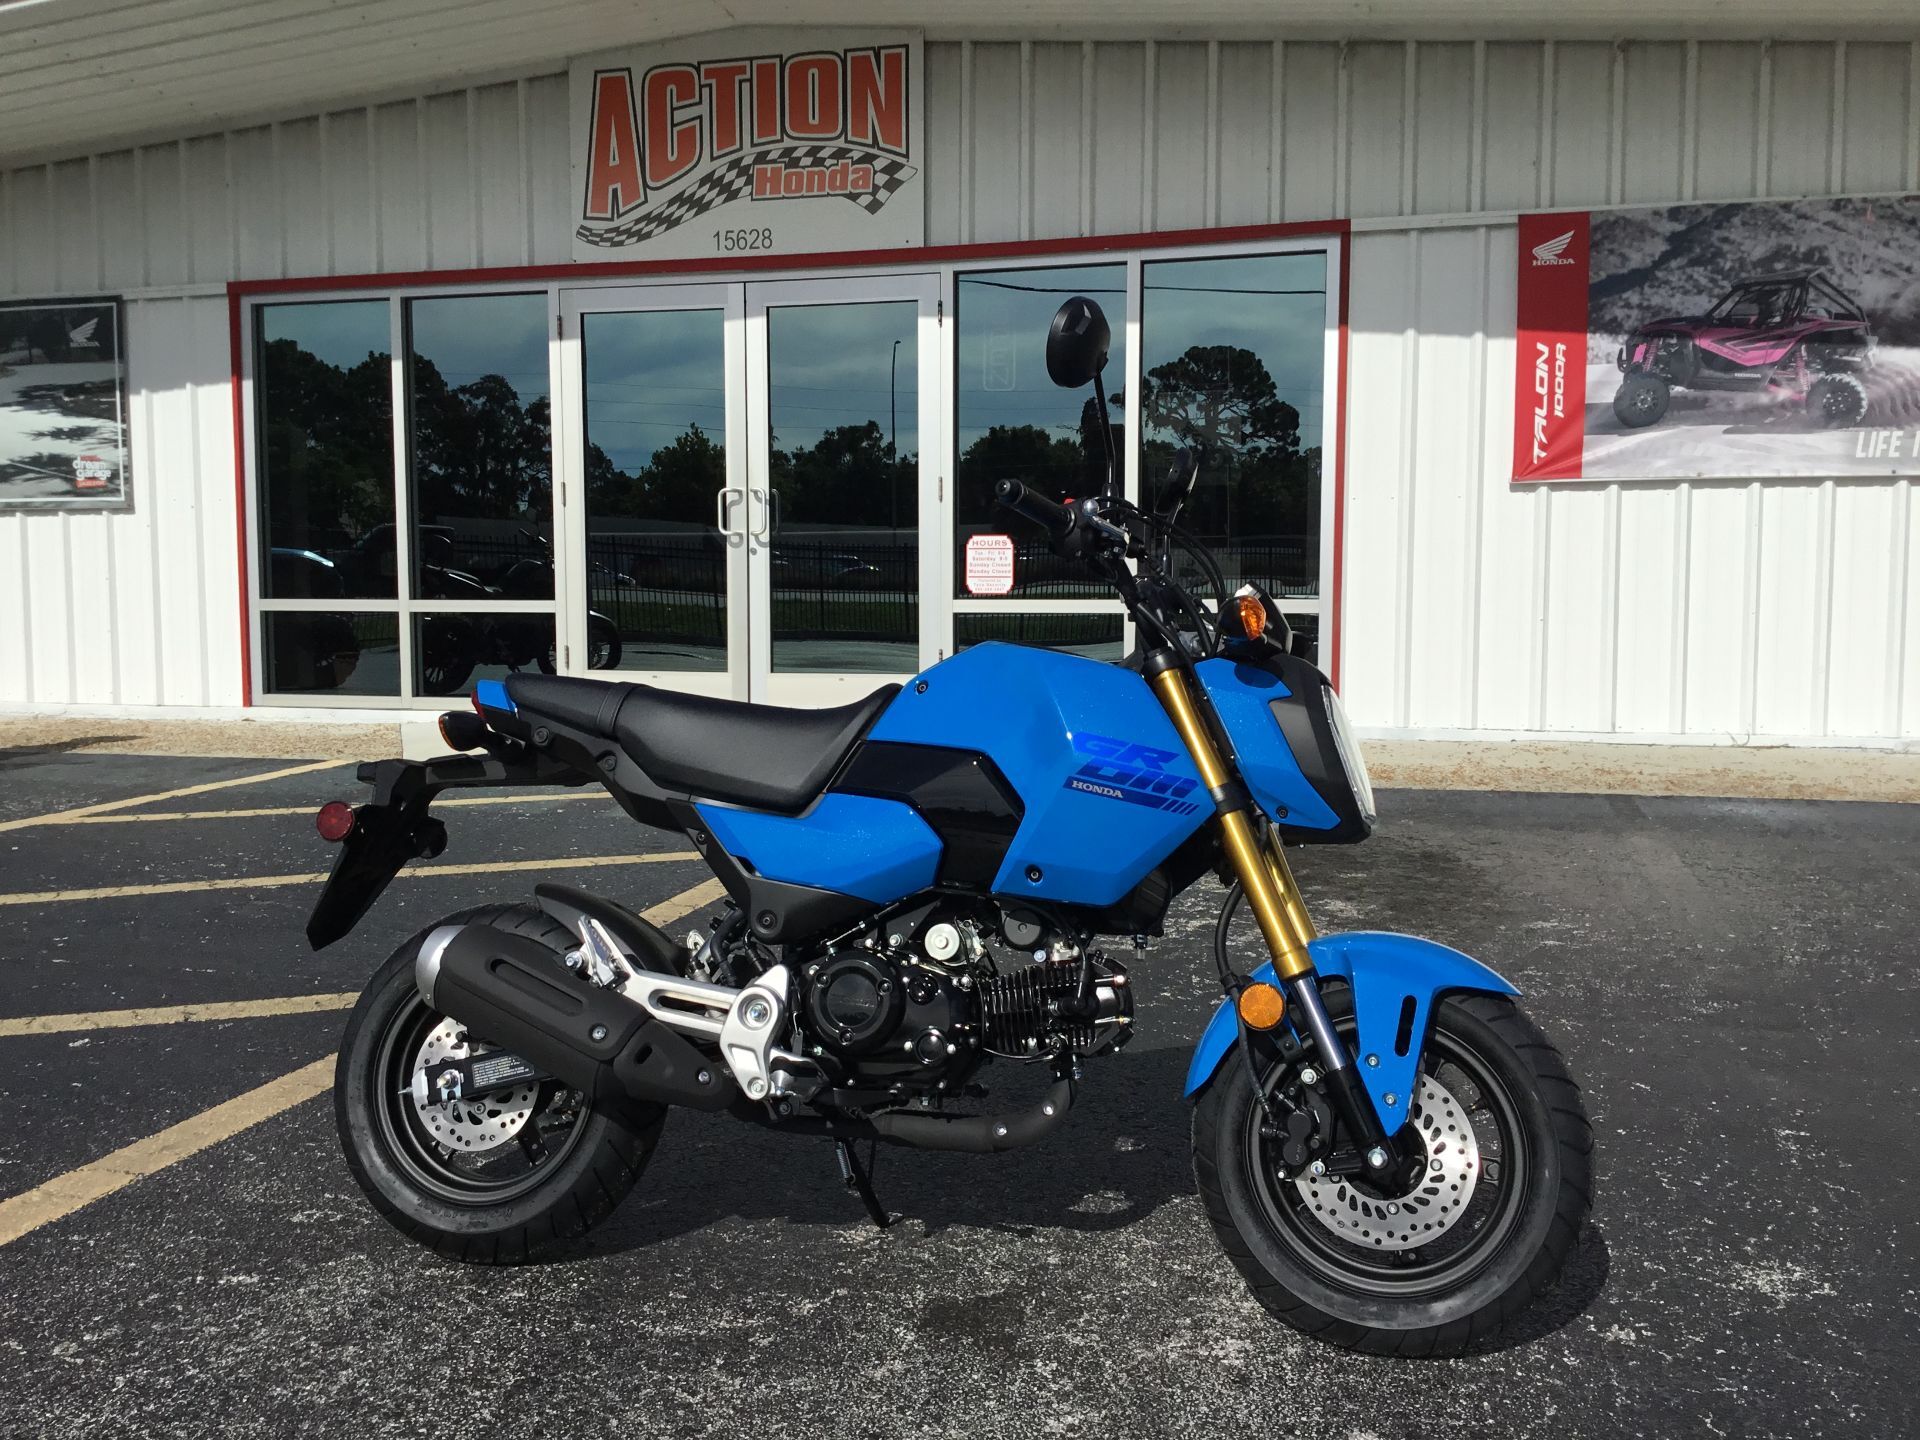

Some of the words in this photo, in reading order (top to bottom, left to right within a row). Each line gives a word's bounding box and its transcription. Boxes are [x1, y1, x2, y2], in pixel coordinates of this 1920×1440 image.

[582, 44, 909, 221] ACTION
[752, 159, 875, 200] Honda
[712, 229, 773, 252] 15628
[1532, 258, 1576, 266] HONDA
[1554, 342, 1567, 419] 1000R
[1533, 342, 1549, 465] TALON
[1855, 430, 1905, 458] LIFE
[72, 455, 105, 470] dream
[76, 469, 112, 481] garage
[1071, 780, 1123, 798] HONDA
